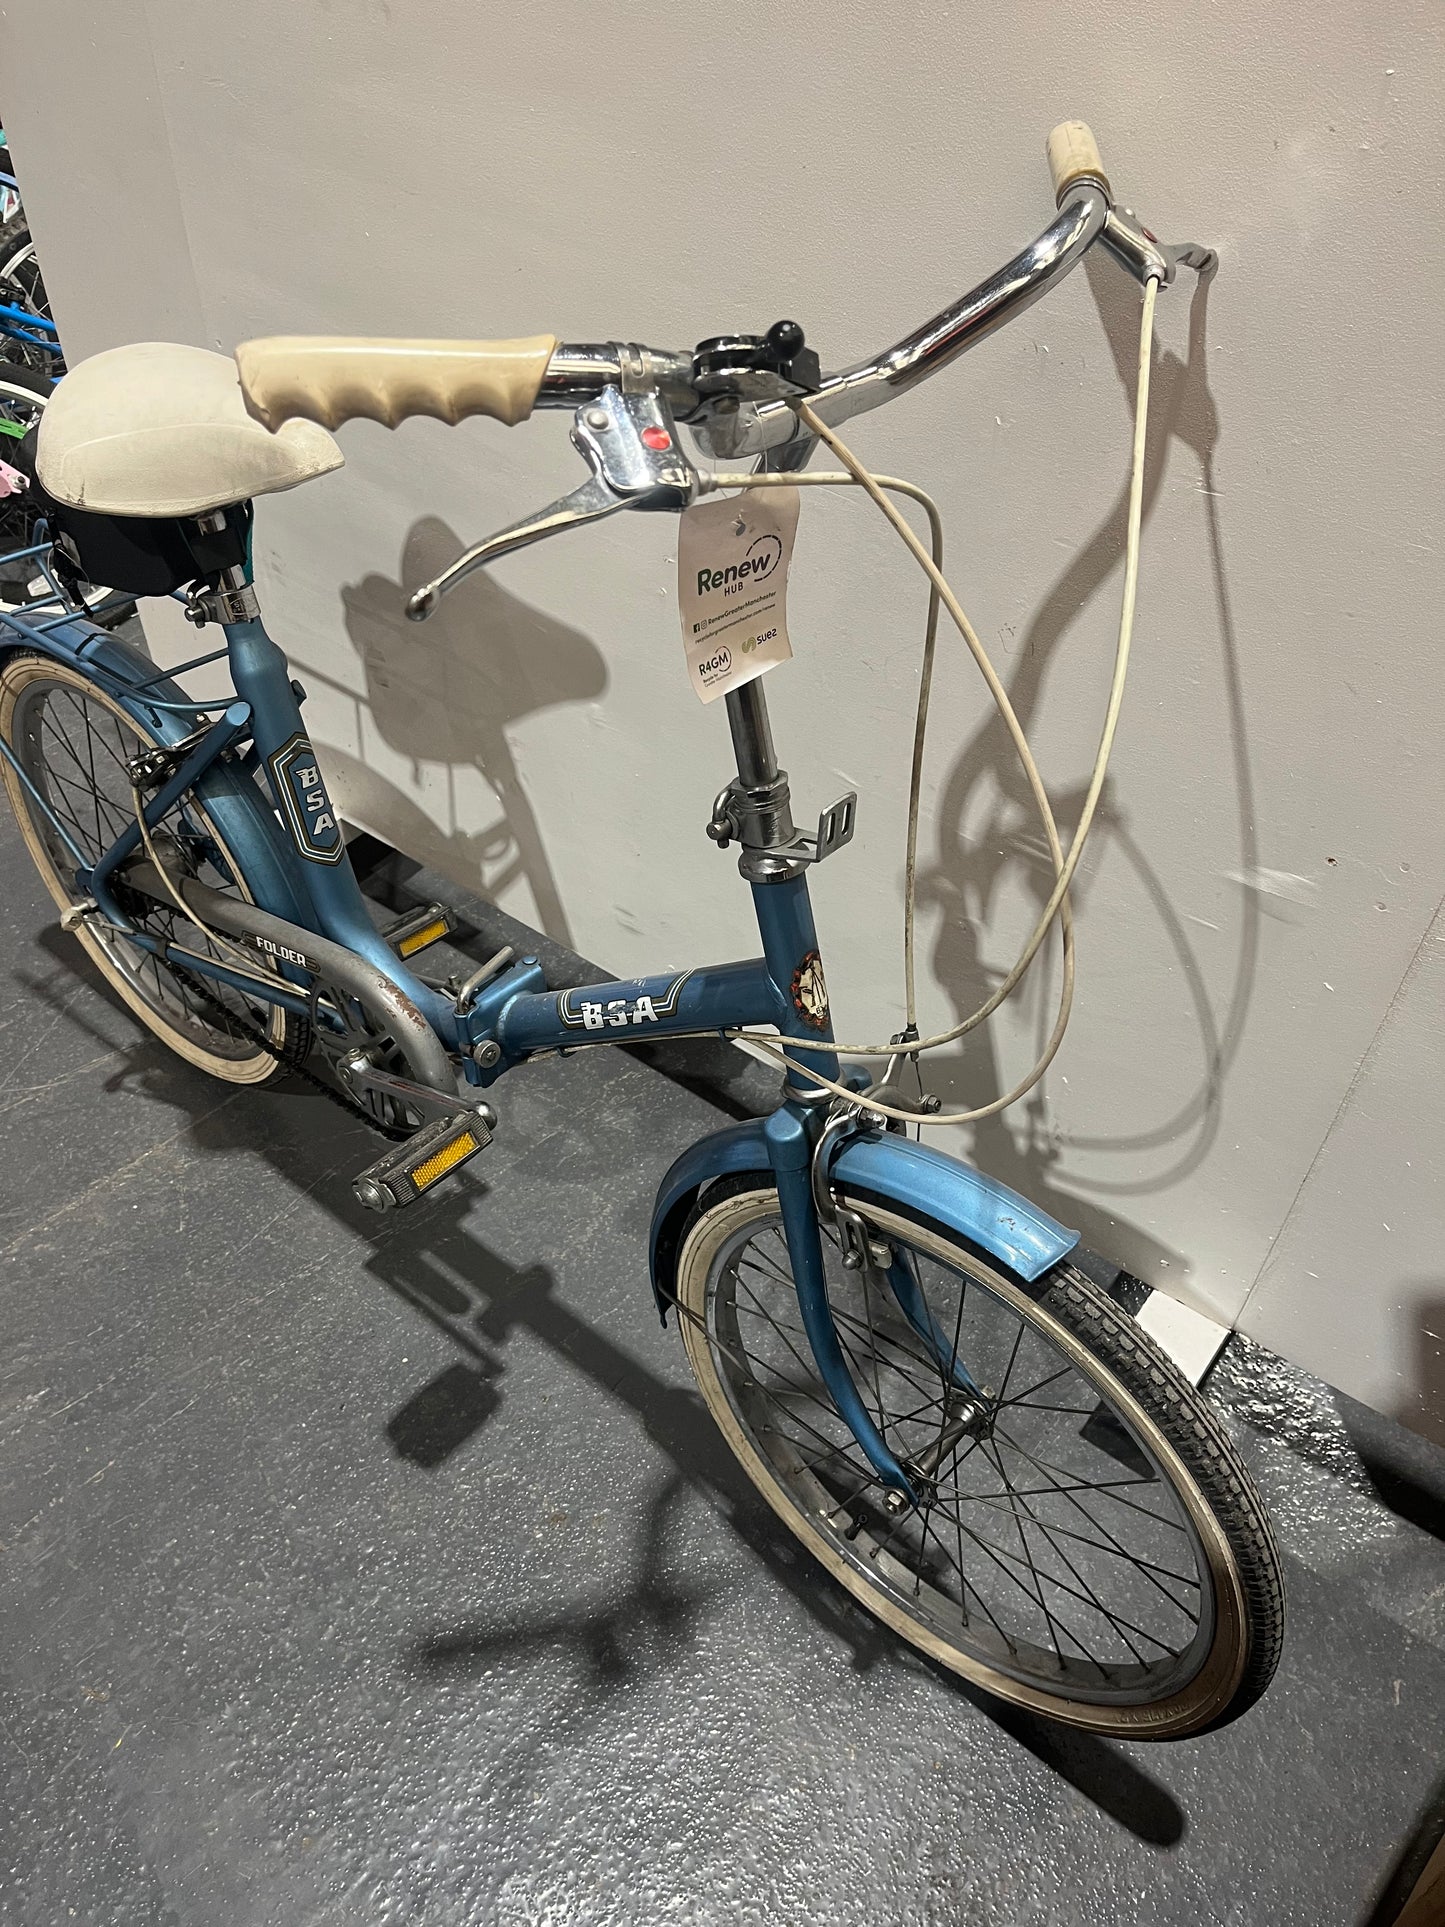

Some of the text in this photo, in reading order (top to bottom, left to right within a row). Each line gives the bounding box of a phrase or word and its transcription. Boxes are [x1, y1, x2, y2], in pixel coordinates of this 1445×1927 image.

[697, 553, 771, 596] Renew
[724, 581, 744, 597] HUB
[698, 652, 729, 676] R4GM
[296, 766, 336, 835] BSA
[255, 936, 307, 968] FOLDER
[580, 996, 659, 1030] BSA
